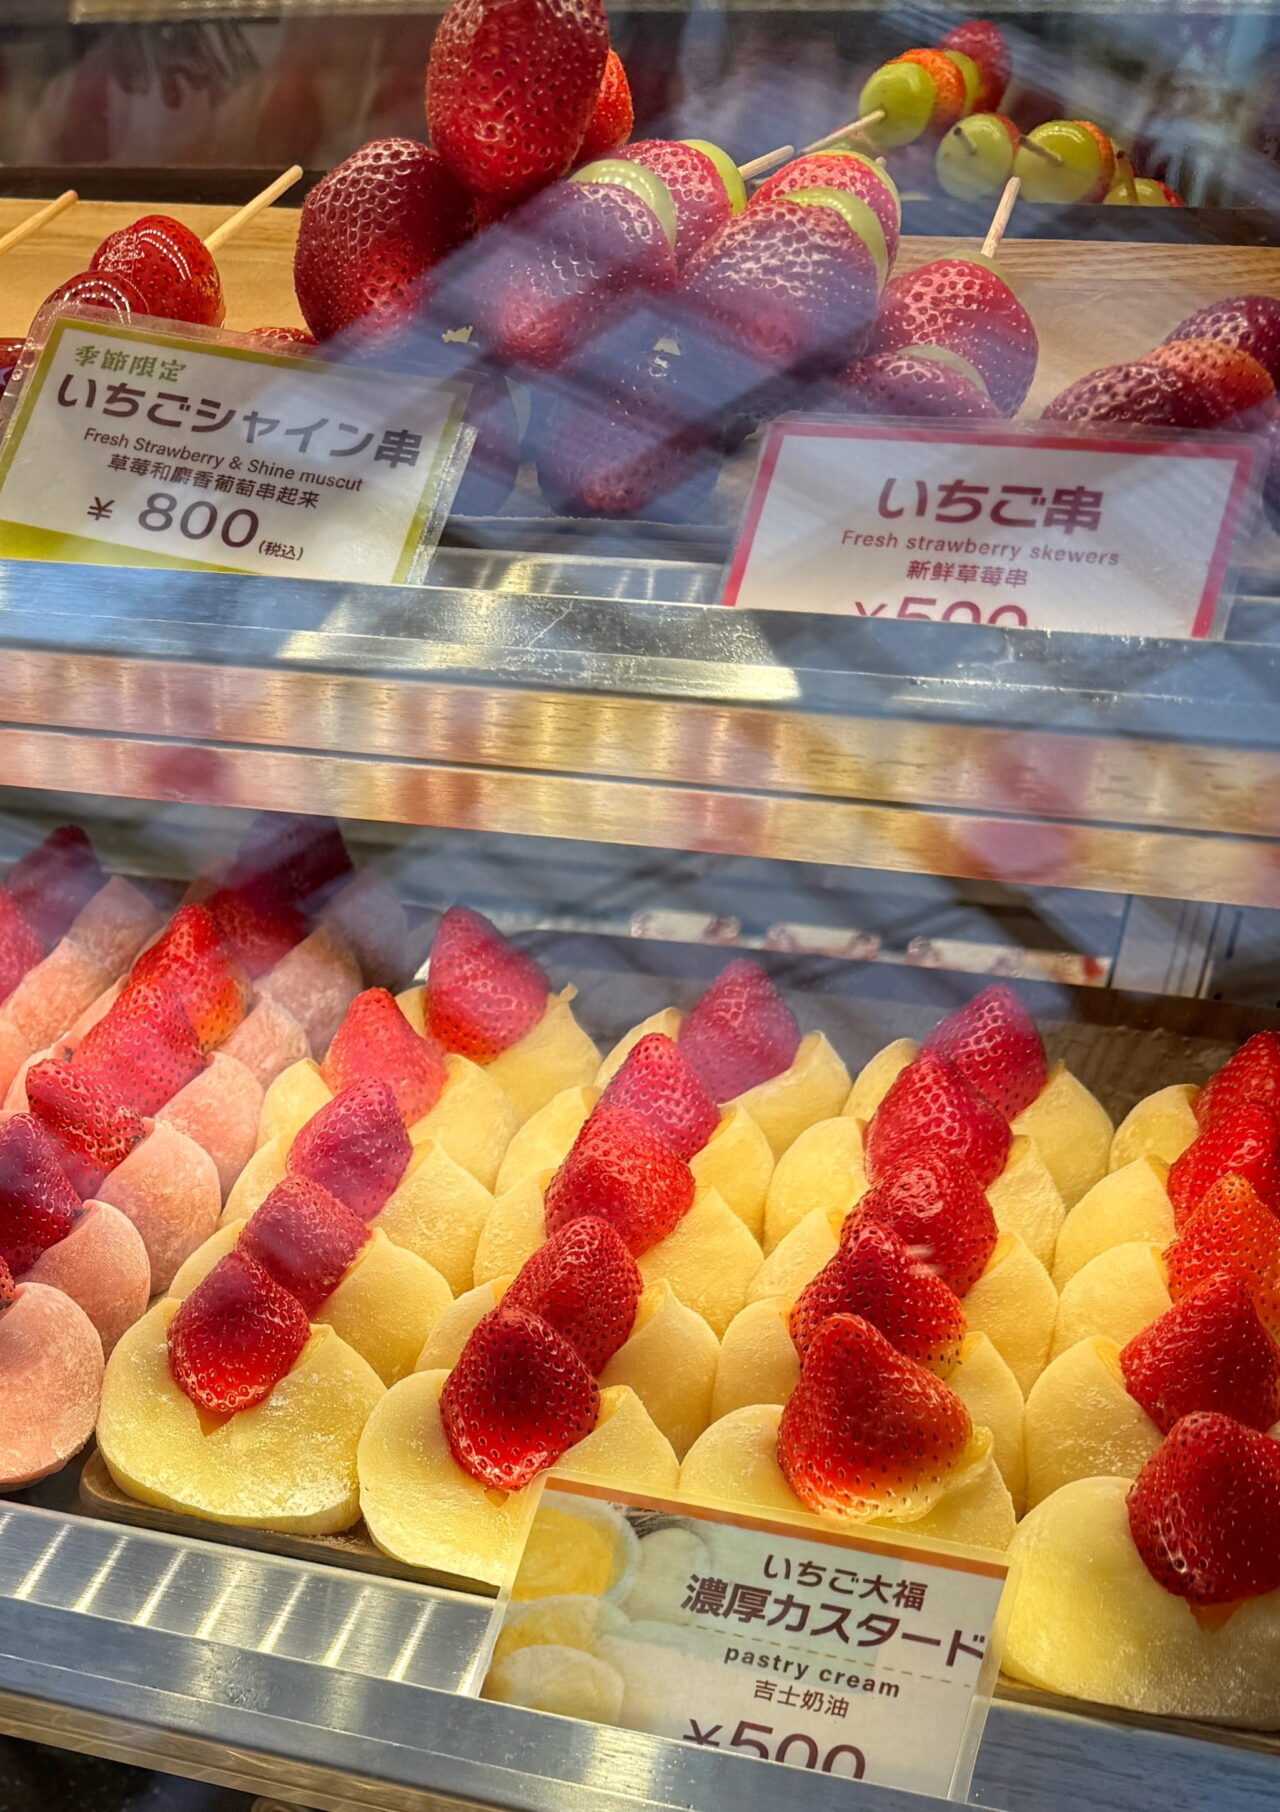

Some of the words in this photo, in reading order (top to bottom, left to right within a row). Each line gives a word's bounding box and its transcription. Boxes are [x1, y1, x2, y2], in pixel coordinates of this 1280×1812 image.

[75, 344, 187, 382] 季節限定
[57, 373, 423, 469] いちごシャイン串
[83, 427, 129, 449] Fresh
[133, 437, 225, 469] Strawberry
[228, 456, 243, 471] &
[247, 458, 295, 480] Shine
[298, 471, 364, 492] muscut
[107, 453, 321, 510] 草莓和麝香葡萄串起来
[137, 491, 260, 549] 800
[877, 477, 1105, 535] いちご串
[258, 540, 304, 562] (税込)
[841, 529, 898, 549] Fresh
[905, 535, 1022, 562] strawberry
[1029, 544, 1120, 566] skewers
[906, 559, 1028, 589] 新鲜草莓串
[763, 1554, 928, 1612] いちご大福
[680, 1573, 986, 1667] 濃厚カスタード
[723, 1646, 810, 1681] pastry
[818, 1667, 901, 1699] cream
[753, 1678, 851, 1719] 吉士奶油
